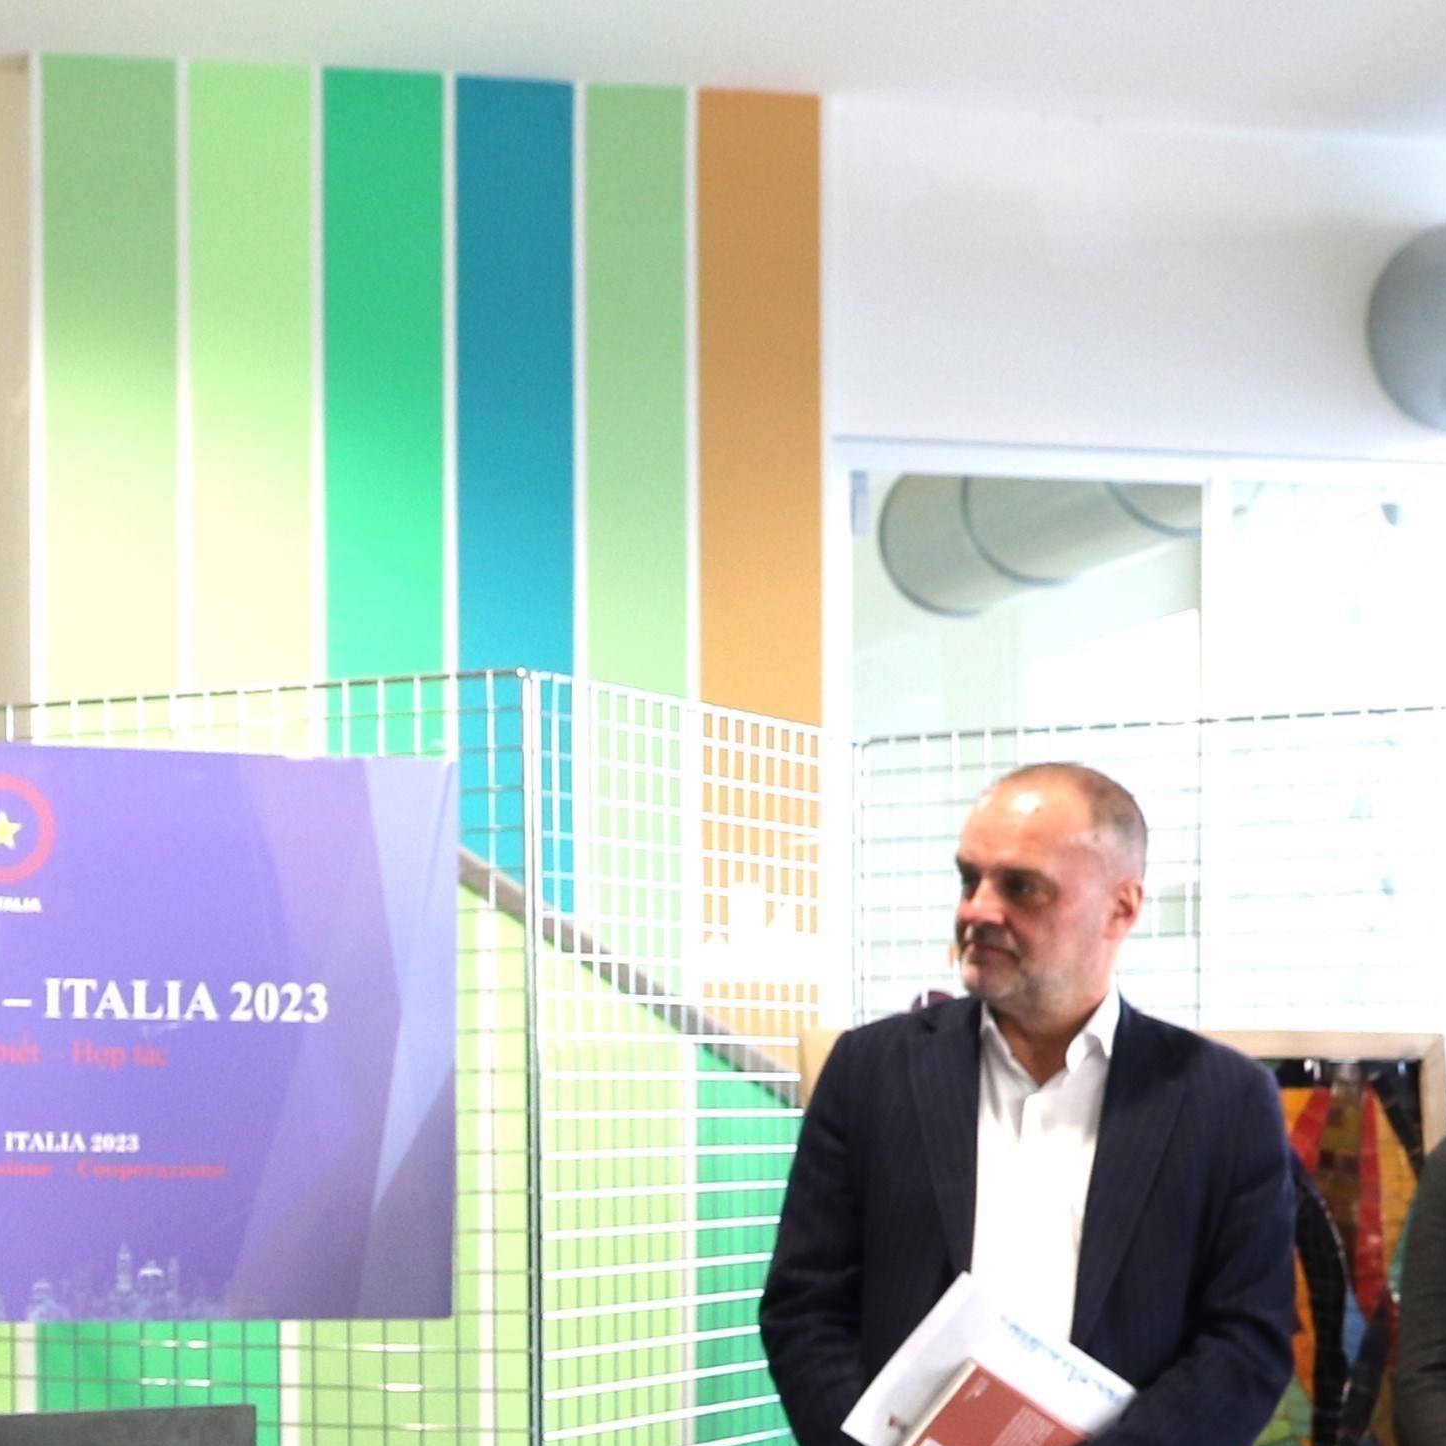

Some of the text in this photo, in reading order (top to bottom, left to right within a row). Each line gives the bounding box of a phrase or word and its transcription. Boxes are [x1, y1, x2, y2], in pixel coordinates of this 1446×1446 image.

[44, 977, 219, 1022] ITALIA
[229, 981, 329, 1024] 2023
[4, 1131, 87, 1153] ITALIA
[90, 1133, 140, 1153] 2023
